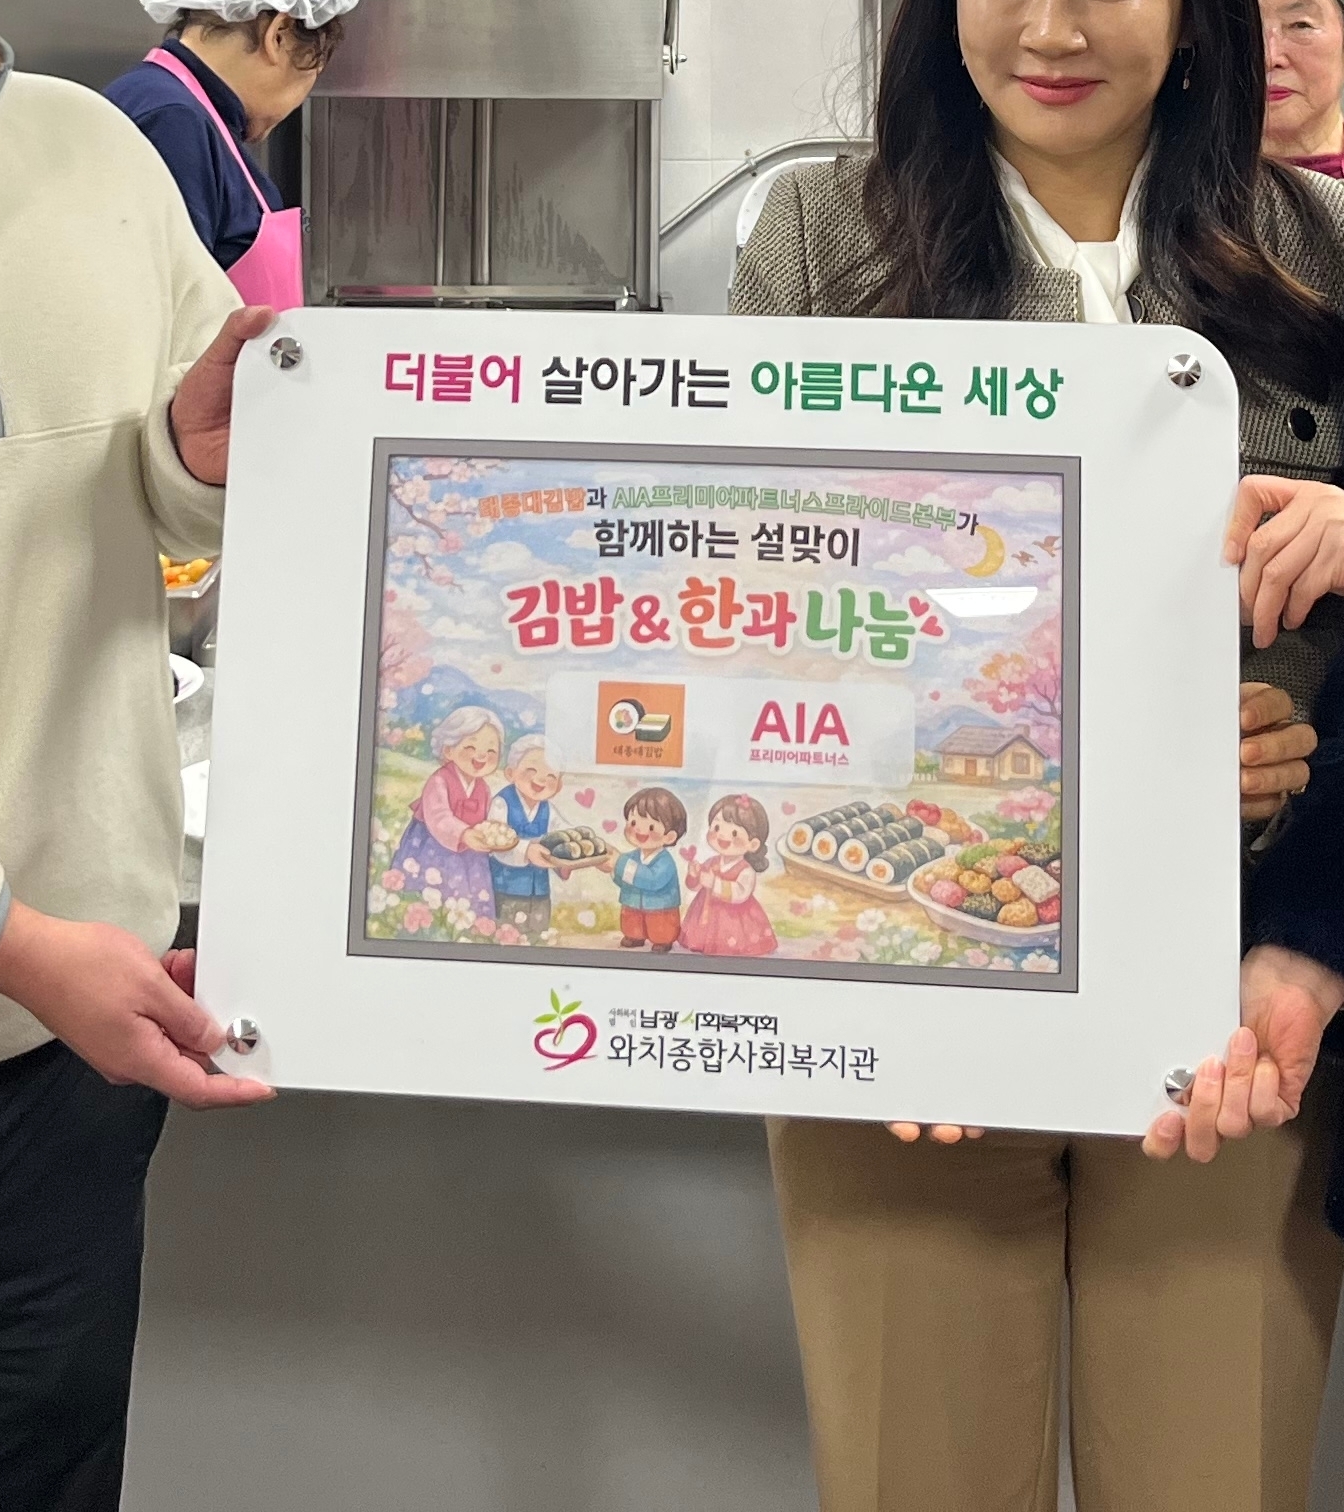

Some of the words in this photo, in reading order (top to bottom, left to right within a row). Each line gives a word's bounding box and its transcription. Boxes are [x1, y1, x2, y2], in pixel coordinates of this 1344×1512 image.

[386, 352, 521, 404] 더불어
[542, 355, 730, 408] 살아가는
[751, 360, 943, 414] 아름다운
[963, 366, 1064, 420] 세상
[478, 487, 607, 520] 태종대김밥과
[612, 484, 979, 537] AIA프리미어파트너스프라이드본부가
[594, 518, 739, 560] 함께하는
[751, 522, 861, 567] 설맞이
[751, 700, 850, 746] AIA
[749, 749, 850, 766] 프리미어파트너스
[607, 1033, 879, 1082] 와치종합사회복지관
